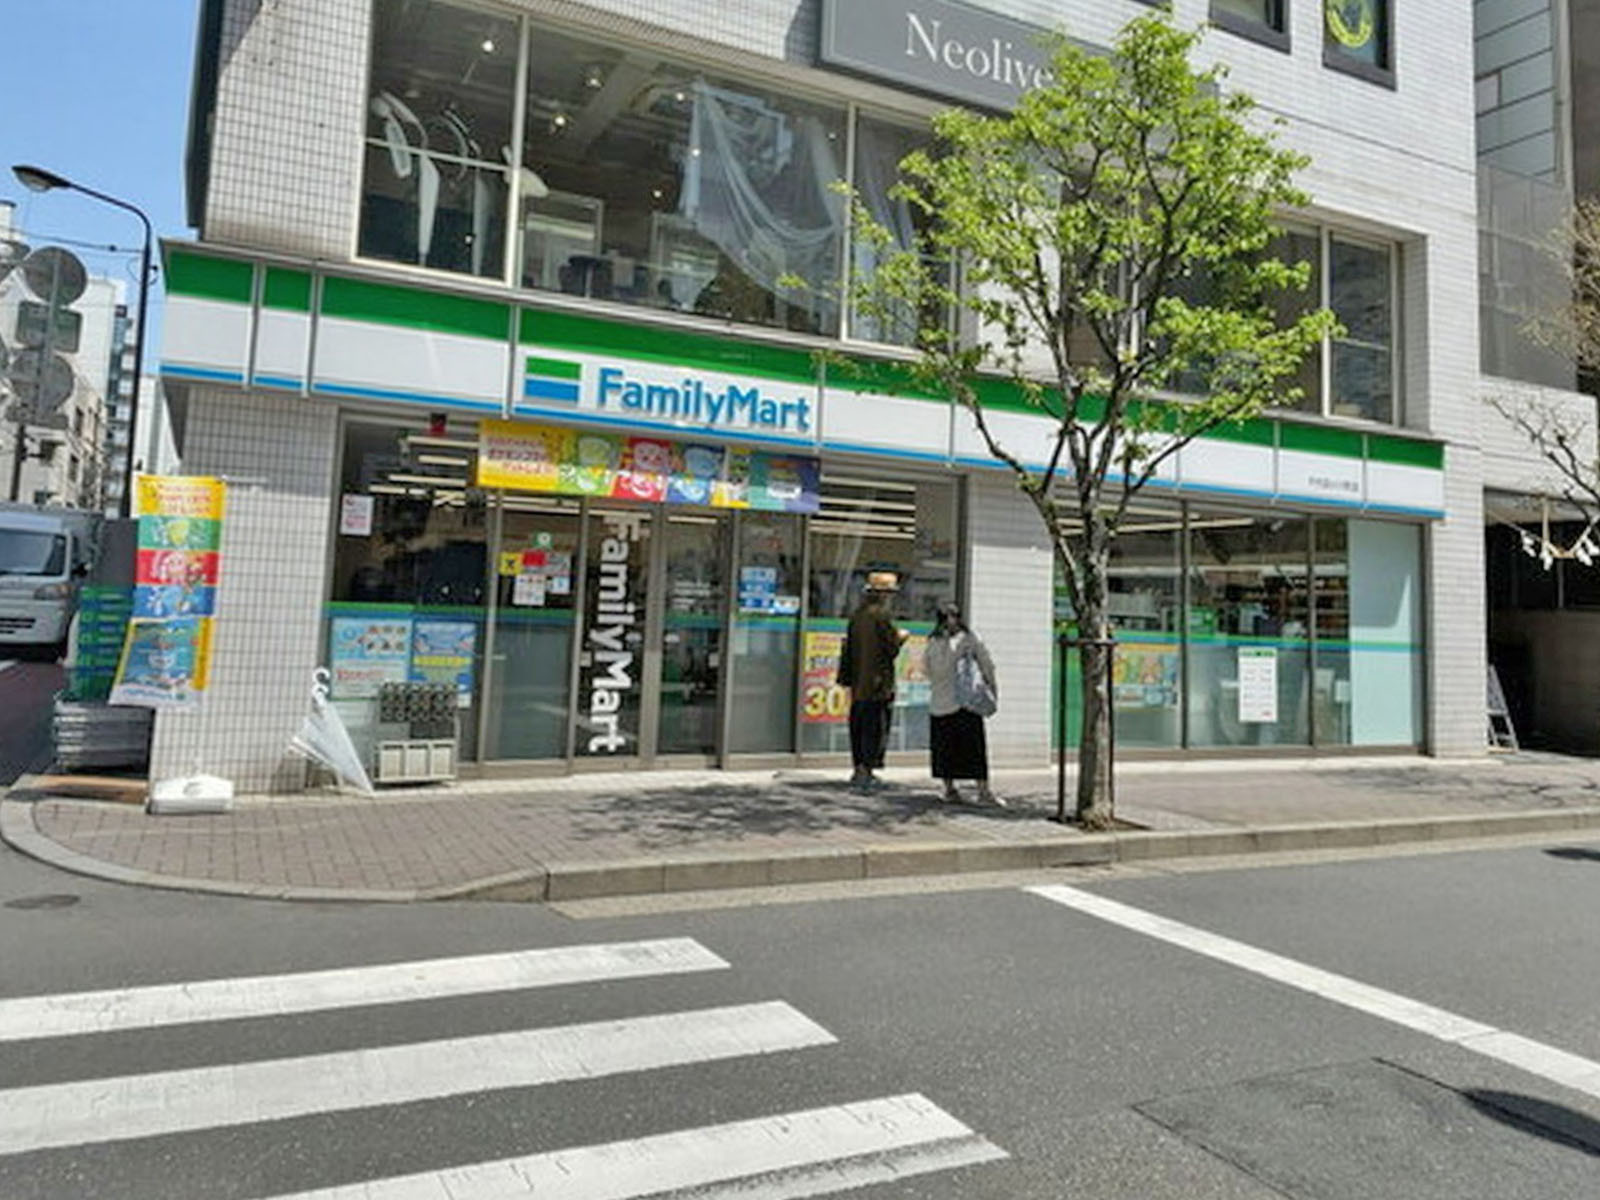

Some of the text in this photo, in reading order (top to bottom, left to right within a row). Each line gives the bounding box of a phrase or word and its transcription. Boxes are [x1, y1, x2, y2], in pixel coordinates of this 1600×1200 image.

[905, 11, 1055, 89] Neolive
[597, 366, 812, 431] FamilyMart
[589, 515, 640, 752] FamilyMart
